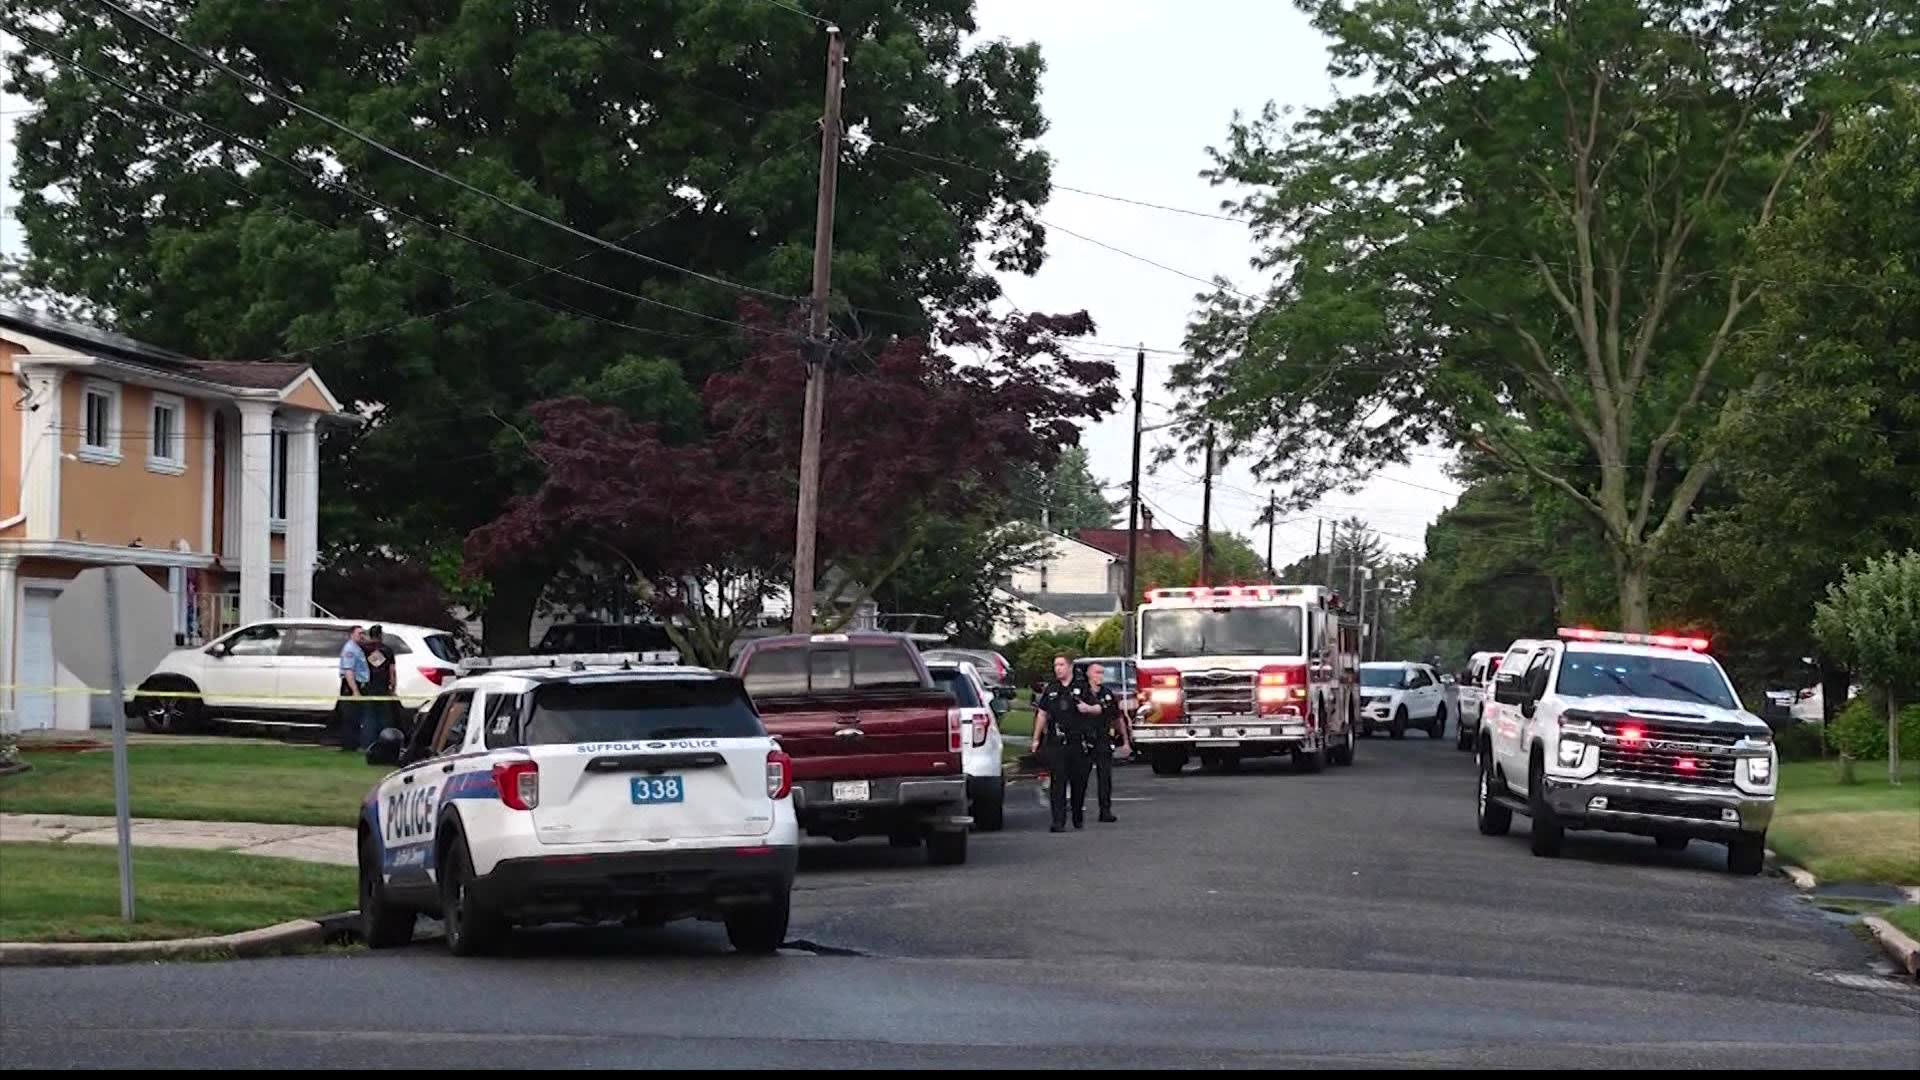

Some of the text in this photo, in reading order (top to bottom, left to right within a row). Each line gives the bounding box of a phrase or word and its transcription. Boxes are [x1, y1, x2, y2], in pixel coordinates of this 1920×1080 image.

[576, 740, 720, 754] SUFFOLK POLICE
[637, 779, 679, 799] 338
[386, 785, 437, 841] POLICE
